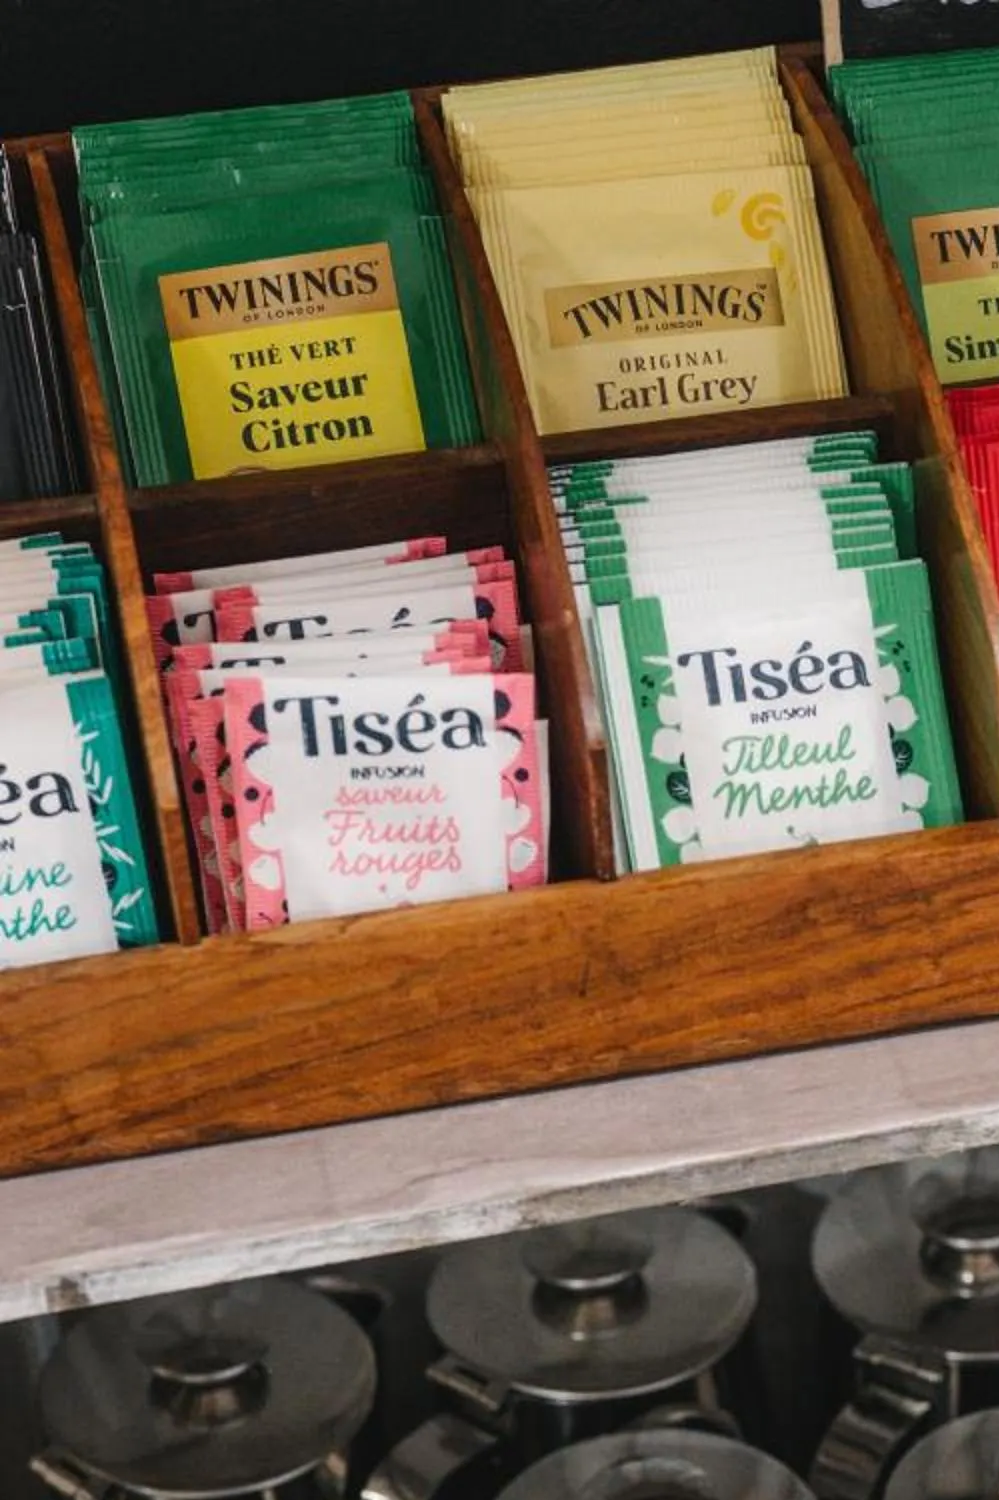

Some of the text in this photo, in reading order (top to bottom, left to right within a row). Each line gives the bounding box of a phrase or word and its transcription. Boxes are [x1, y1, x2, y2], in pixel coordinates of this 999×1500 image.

[179, 260, 379, 319] TWININGS
[243, 304, 326, 324] OF LONDON
[564, 283, 767, 339] TWININGS
[635, 320, 703, 333] OF LONDON
[230, 337, 356, 370] THÉ VERT
[619, 349, 728, 374] ORIGINAL
[230, 372, 368, 413] Saveur
[596, 372, 757, 413] Earl Grey
[242, 414, 373, 453] Citron
[677, 640, 873, 707] Tiséa
[273, 693, 487, 758] Tiséa
[750, 704, 818, 725] INFUSION
[721, 724, 856, 777] Tilleul
[350, 764, 425, 780] INFUSION
[713, 774, 878, 819] Menthe
[323, 810, 460, 846] Fruits
[329, 846, 462, 891] rouges
